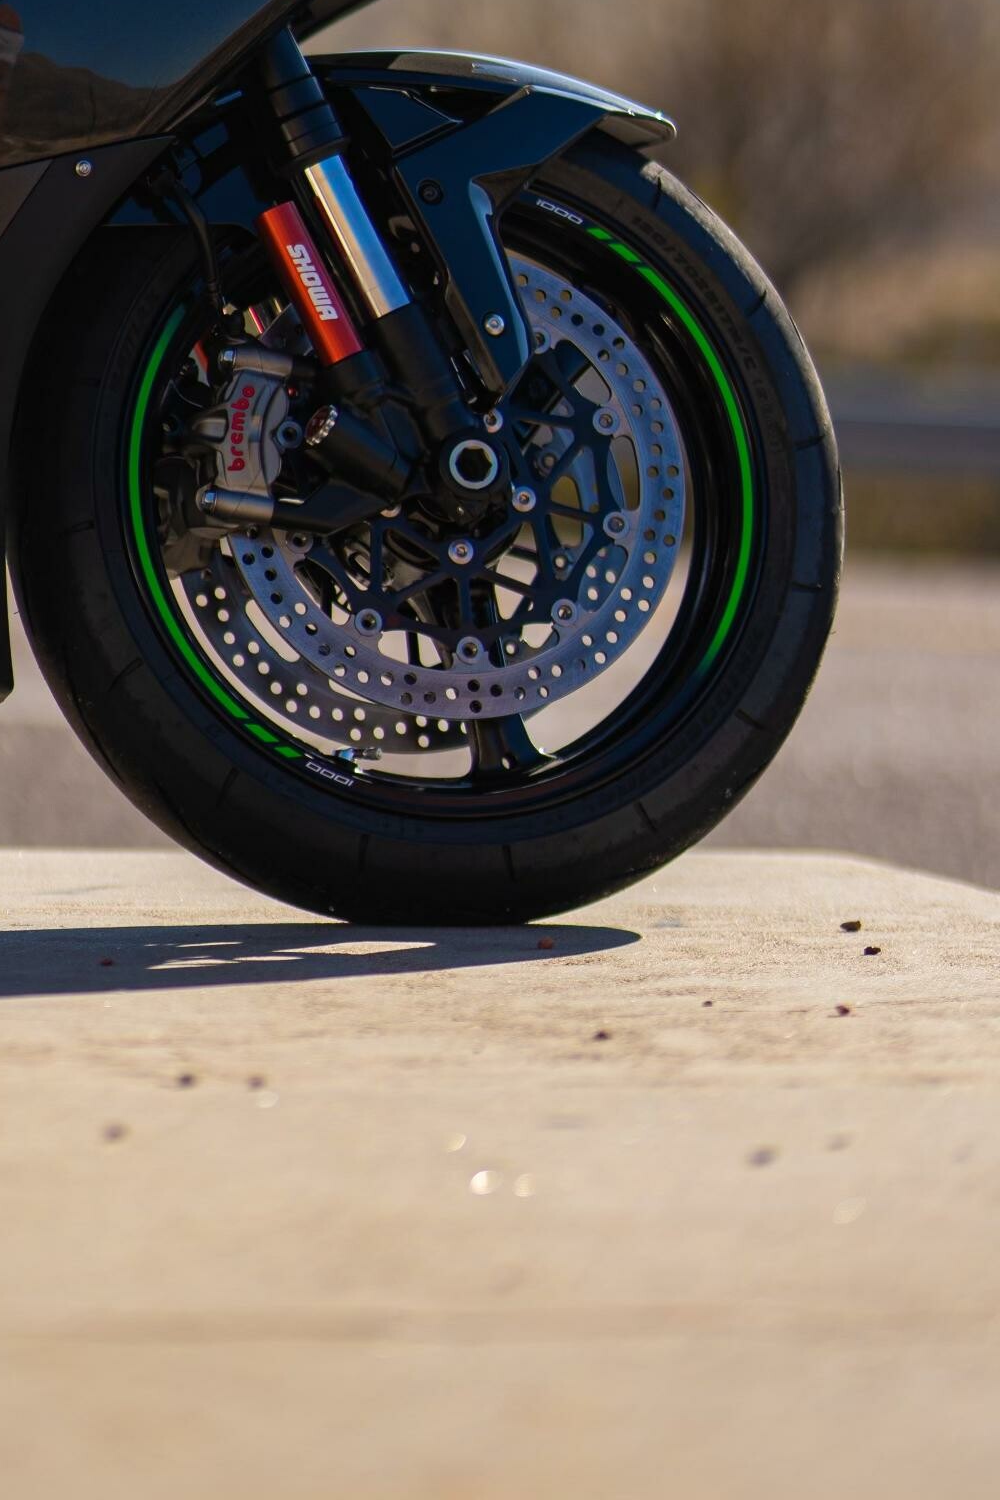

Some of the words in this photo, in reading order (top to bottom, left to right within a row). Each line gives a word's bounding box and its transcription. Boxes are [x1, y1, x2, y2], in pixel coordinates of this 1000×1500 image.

[535, 198, 584, 225] 1000
[286, 243, 339, 322] SHOWA
[227, 385, 256, 472] brembo
[305, 761, 354, 787] 1000
